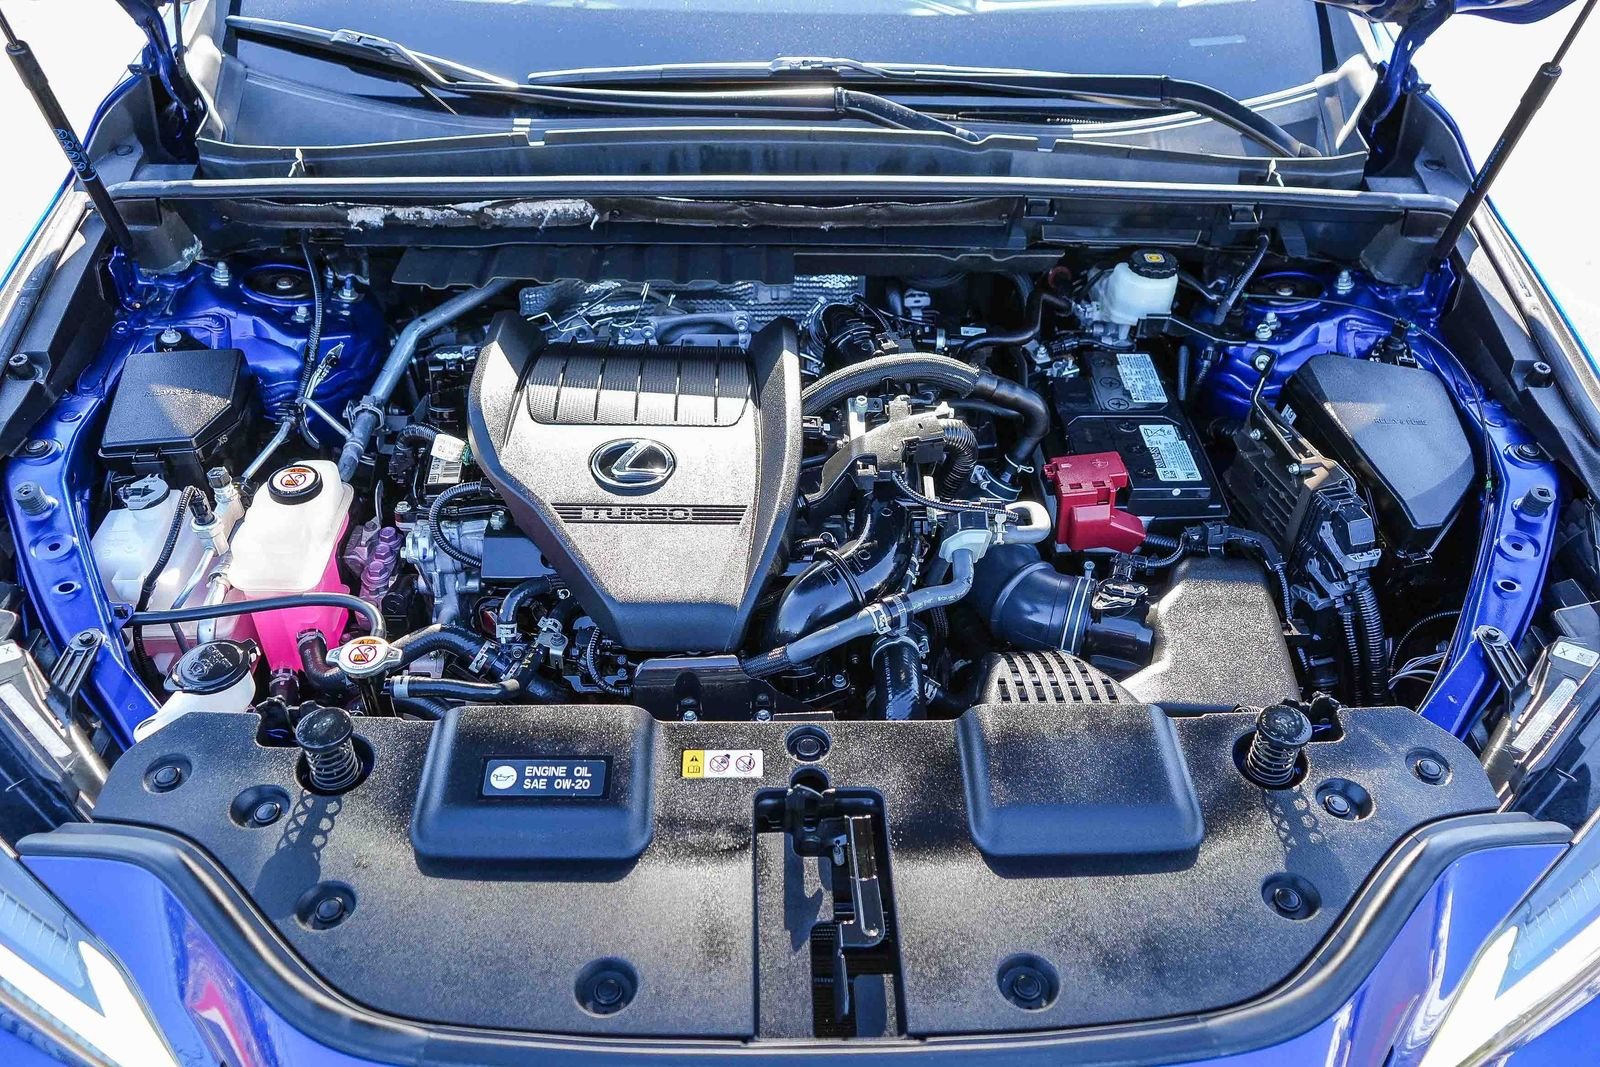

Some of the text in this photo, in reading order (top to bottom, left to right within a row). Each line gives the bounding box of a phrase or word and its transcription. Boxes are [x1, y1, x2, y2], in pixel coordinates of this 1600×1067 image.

[583, 506, 692, 521] TURBO
[525, 766, 592, 777] ENGINE OIL
[523, 778, 590, 790] SAE 0W-20
